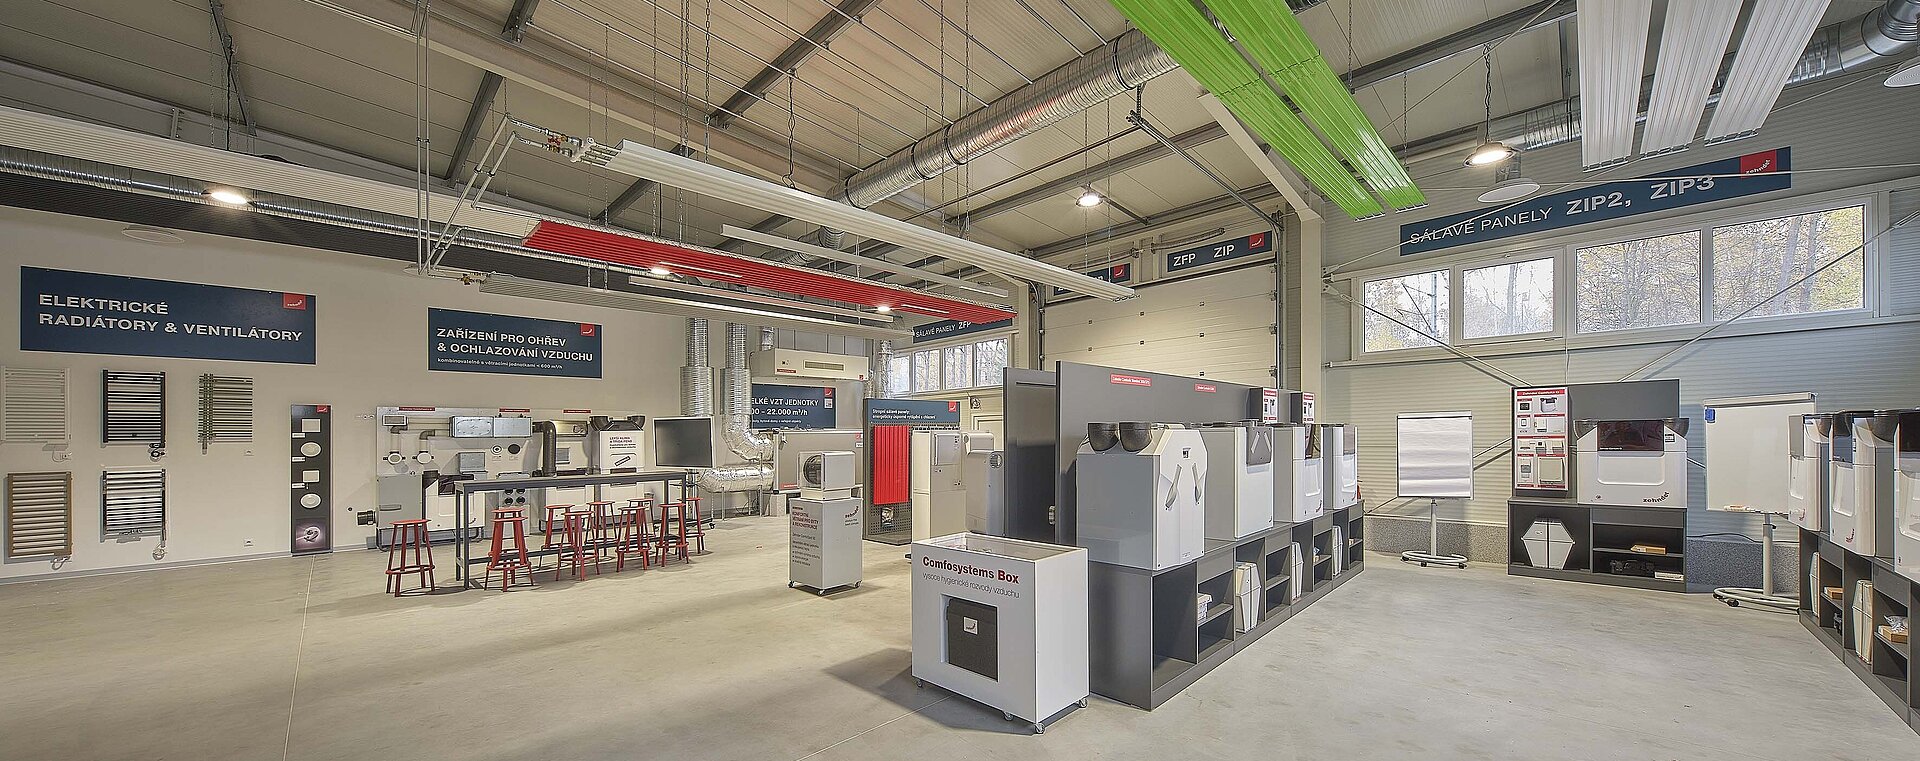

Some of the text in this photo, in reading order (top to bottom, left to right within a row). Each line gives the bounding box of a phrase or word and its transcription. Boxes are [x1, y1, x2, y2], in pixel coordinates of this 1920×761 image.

[1410, 175, 1715, 244] SÁLAVÉ PANELY ZIP2, ZIP3
[1173, 245, 1235, 267] ZFP ZIP
[39, 294, 169, 315] ELEKTRICKÉ
[39, 313, 303, 342] RADIÁTORY & VENTILÁTORY
[916, 328, 935, 338] SÁLAVÉ
[935, 324, 956, 334] PANELY
[437, 328, 566, 347] ZAŘÍZENÍ PRO OHŘEV
[437, 342, 593, 362] & OCHLAZOVÁNÍ VZDUCHU
[752, 397, 768, 405] ELKÉ
[767, 408, 791, 416] 22.000
[1642, 491, 1669, 503] zehnder
[922, 556, 1020, 584] Comfosystems Box
[969, 582, 992, 594] rozvody
[992, 586, 1020, 599] vzduchu
